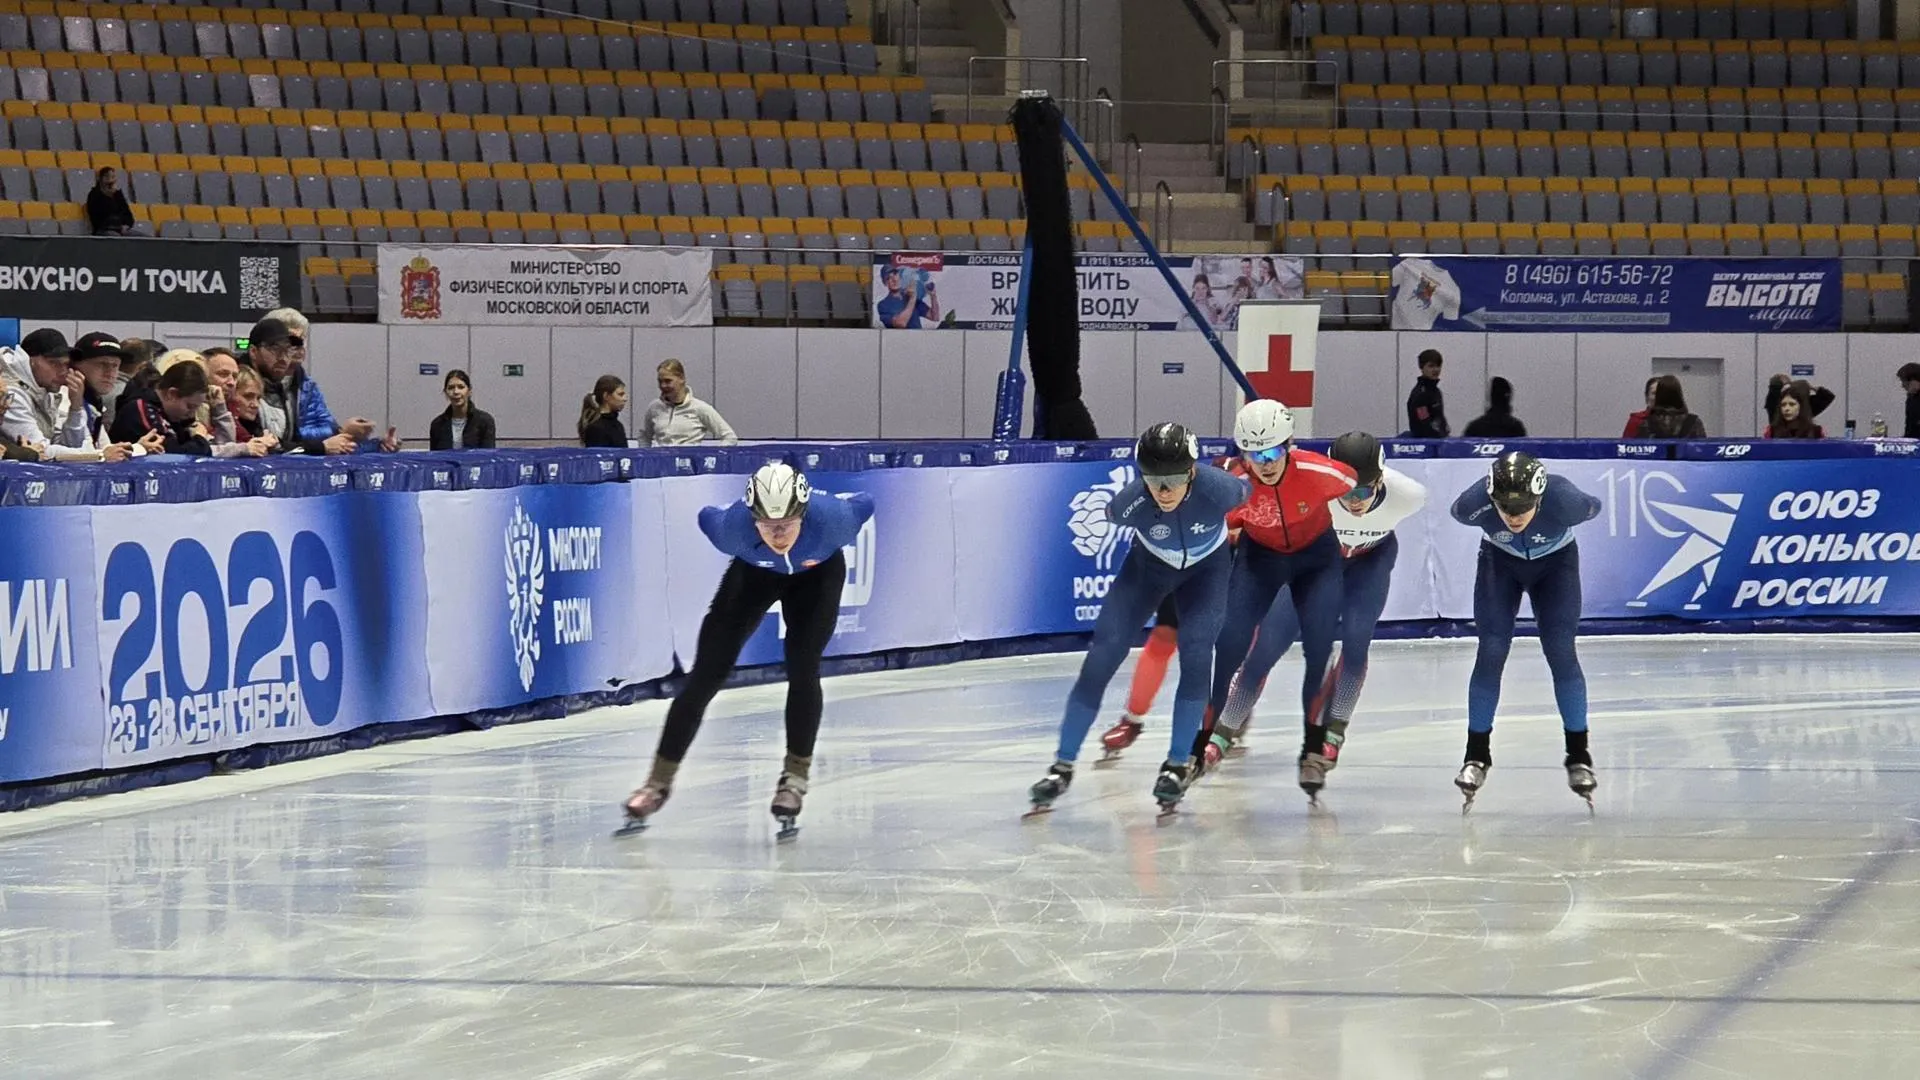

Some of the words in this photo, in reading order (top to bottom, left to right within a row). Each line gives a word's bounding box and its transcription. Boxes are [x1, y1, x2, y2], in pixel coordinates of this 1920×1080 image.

[510, 260, 621, 275] МИНИСТЕРСТВО
[968, 255, 1018, 265] ДОСТАВКА
[148, 268, 227, 295] ТОЧКА
[1505, 264, 1517, 285] 8
[1523, 264, 1571, 285] (496)
[1577, 264, 1673, 286] 615-56-72
[449, 278, 543, 294] ФИЗИЧЕСКОЙ
[545, 281, 616, 295] КУЛЬТУРЫ
[619, 281, 629, 295] И
[632, 281, 688, 295] СПОРТА
[1660, 290, 1670, 304] 2
[1705, 283, 1822, 307] ВЫСОТА
[487, 298, 582, 315] МОСКОВСКОЙ
[585, 301, 650, 315] ОБЛАСТИ
[1081, 298, 1139, 319] ВОДУ
[1769, 489, 1881, 521] СОЮЗ
[1732, 576, 1889, 609] РОССИИ
[103, 530, 343, 727] 2026
[180, 682, 299, 745] СЕНТЯБРЯ
